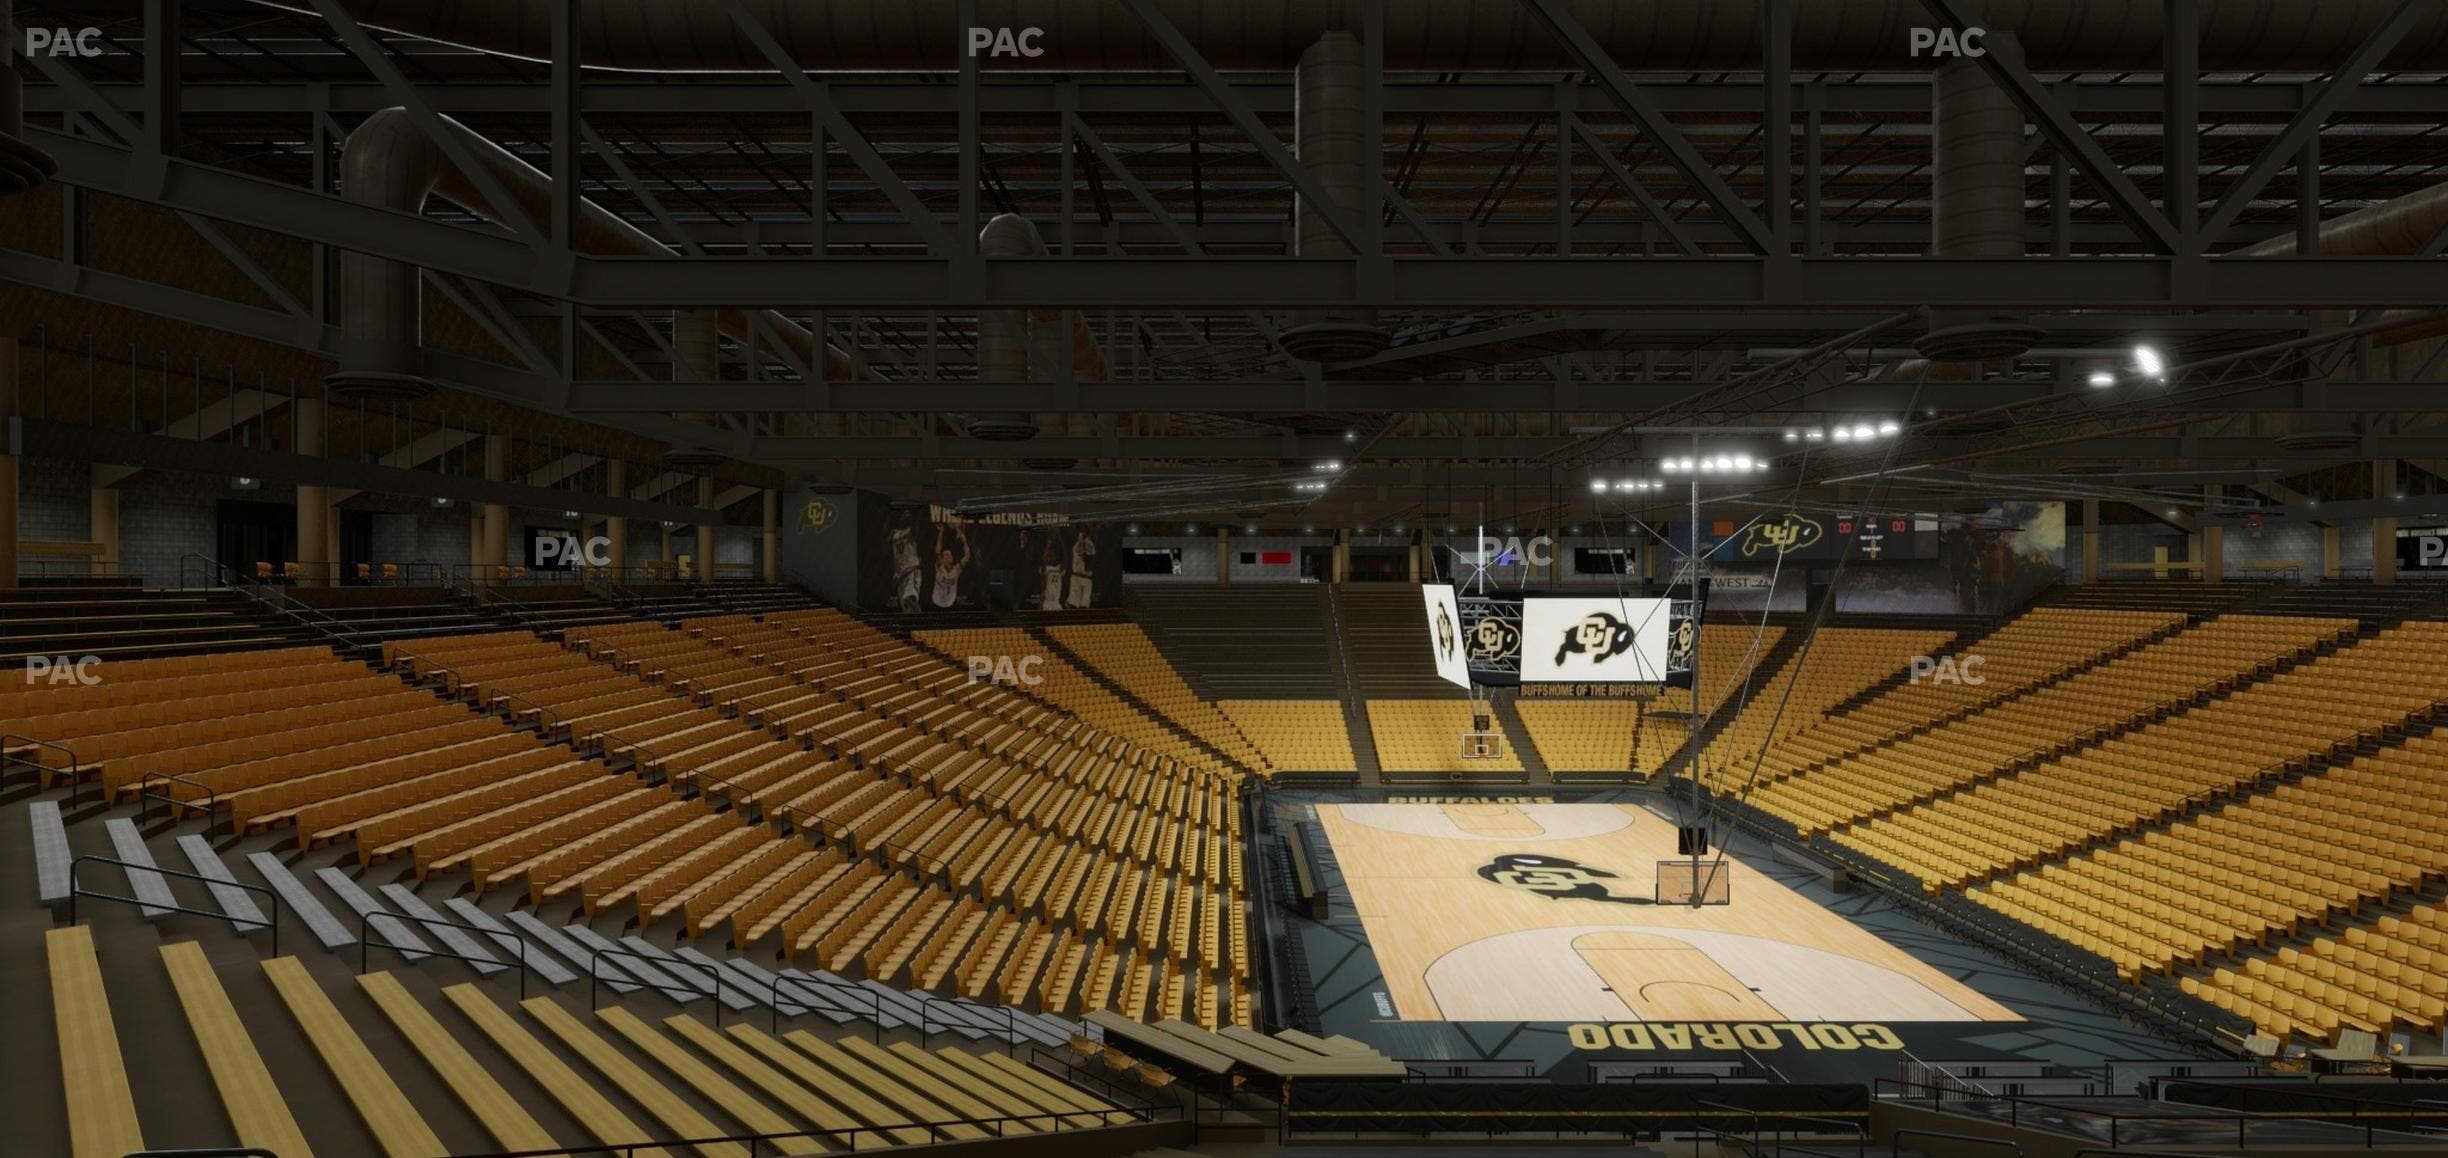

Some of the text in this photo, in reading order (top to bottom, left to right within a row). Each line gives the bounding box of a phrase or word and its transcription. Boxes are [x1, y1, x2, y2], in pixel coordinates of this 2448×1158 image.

[1714, 577, 1750, 588] WEST
[1478, 621, 1505, 651] CU
[1575, 616, 1616, 654] CU
[1576, 684, 1588, 697] OF
[1590, 684, 1606, 697] THE
[1388, 796, 1554, 804] BUFFALOES
[1566, 1022, 1905, 1051] COLORADO
